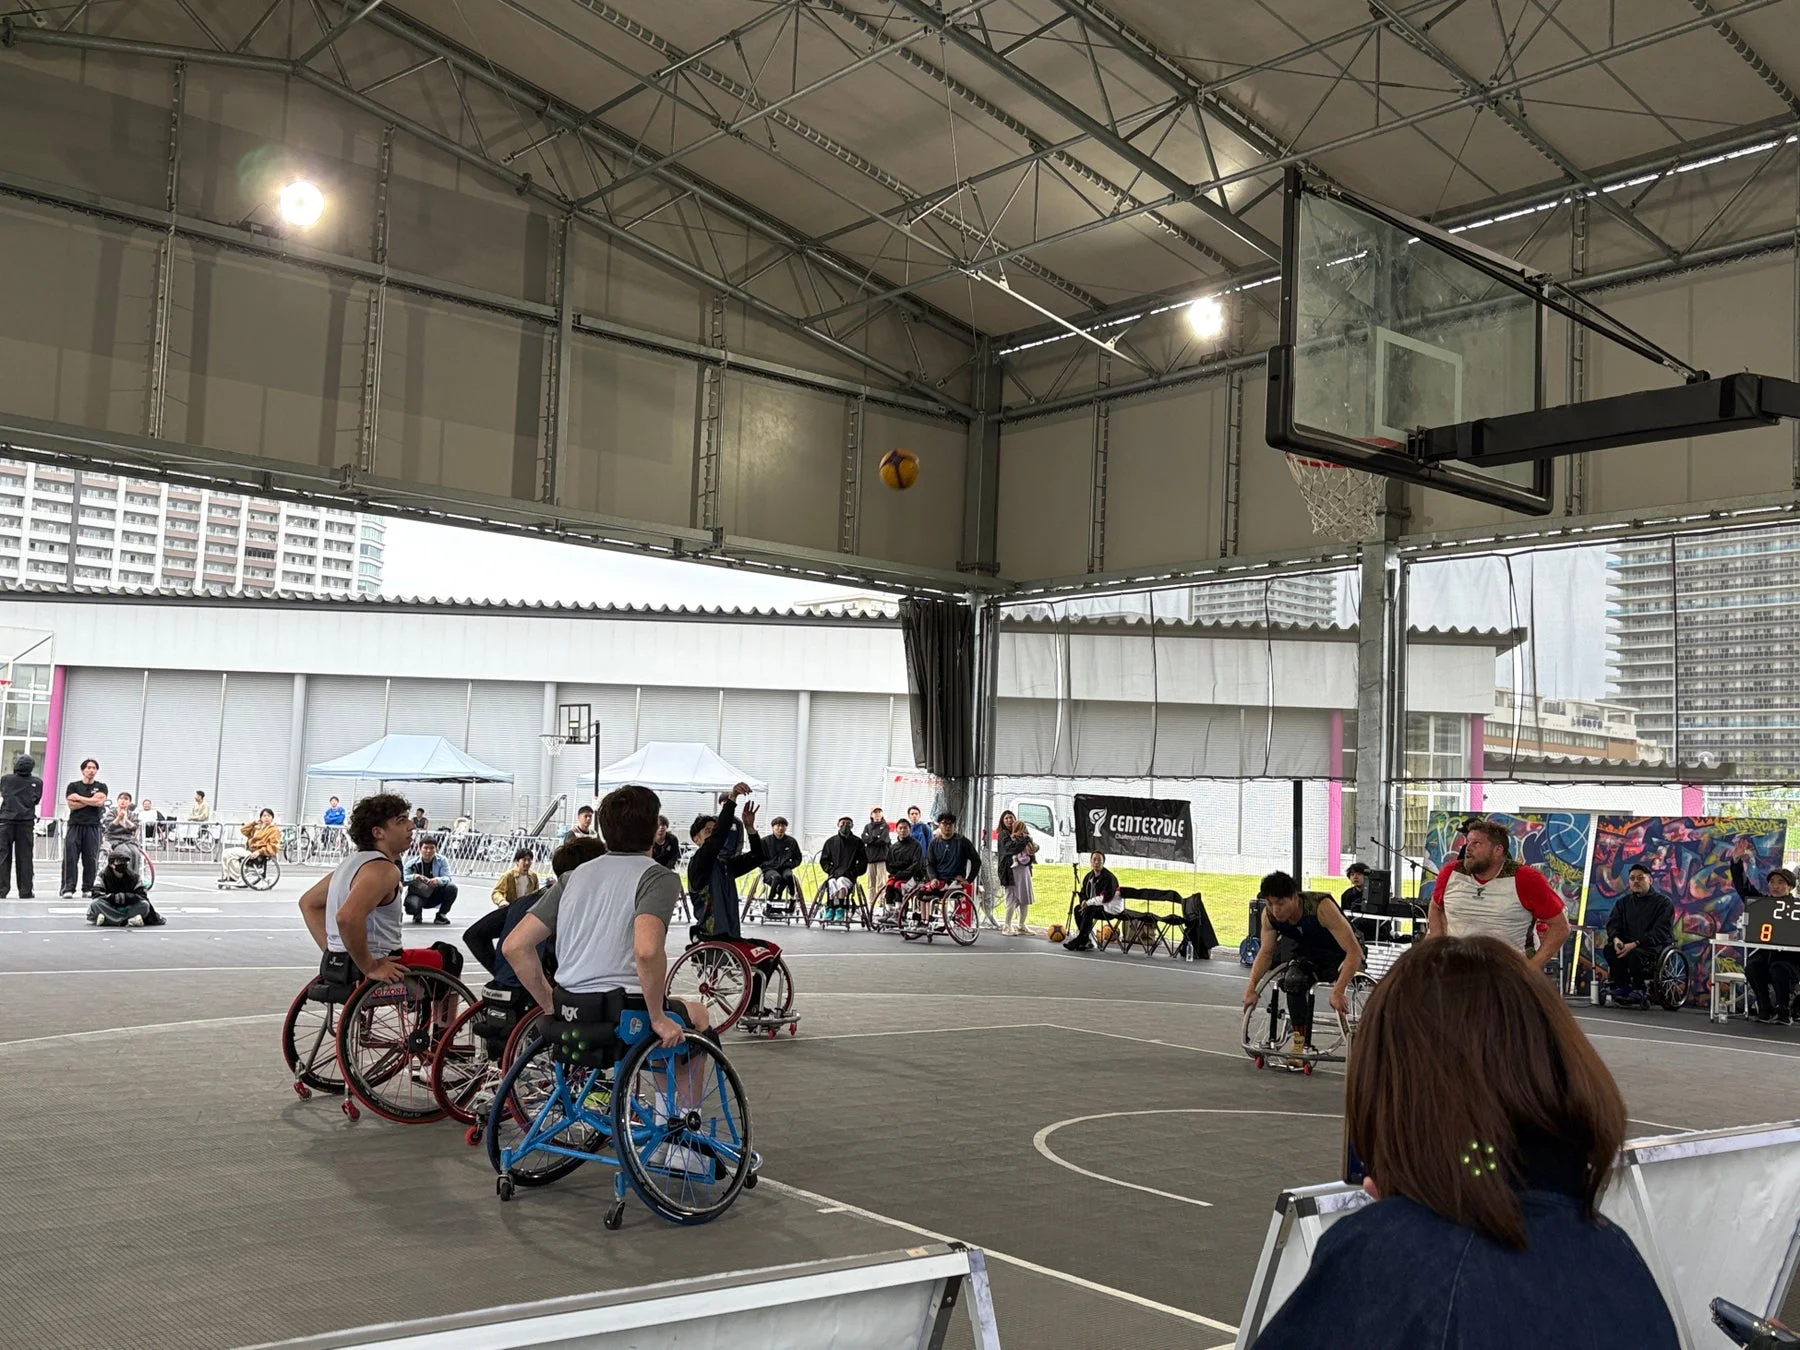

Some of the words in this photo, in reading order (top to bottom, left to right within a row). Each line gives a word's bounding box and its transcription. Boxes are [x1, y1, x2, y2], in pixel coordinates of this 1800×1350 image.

[1110, 814, 1185, 837] CENTERPOLE
[1760, 923, 1773, 942] 8
[371, 986, 407, 997] ARIZONA
